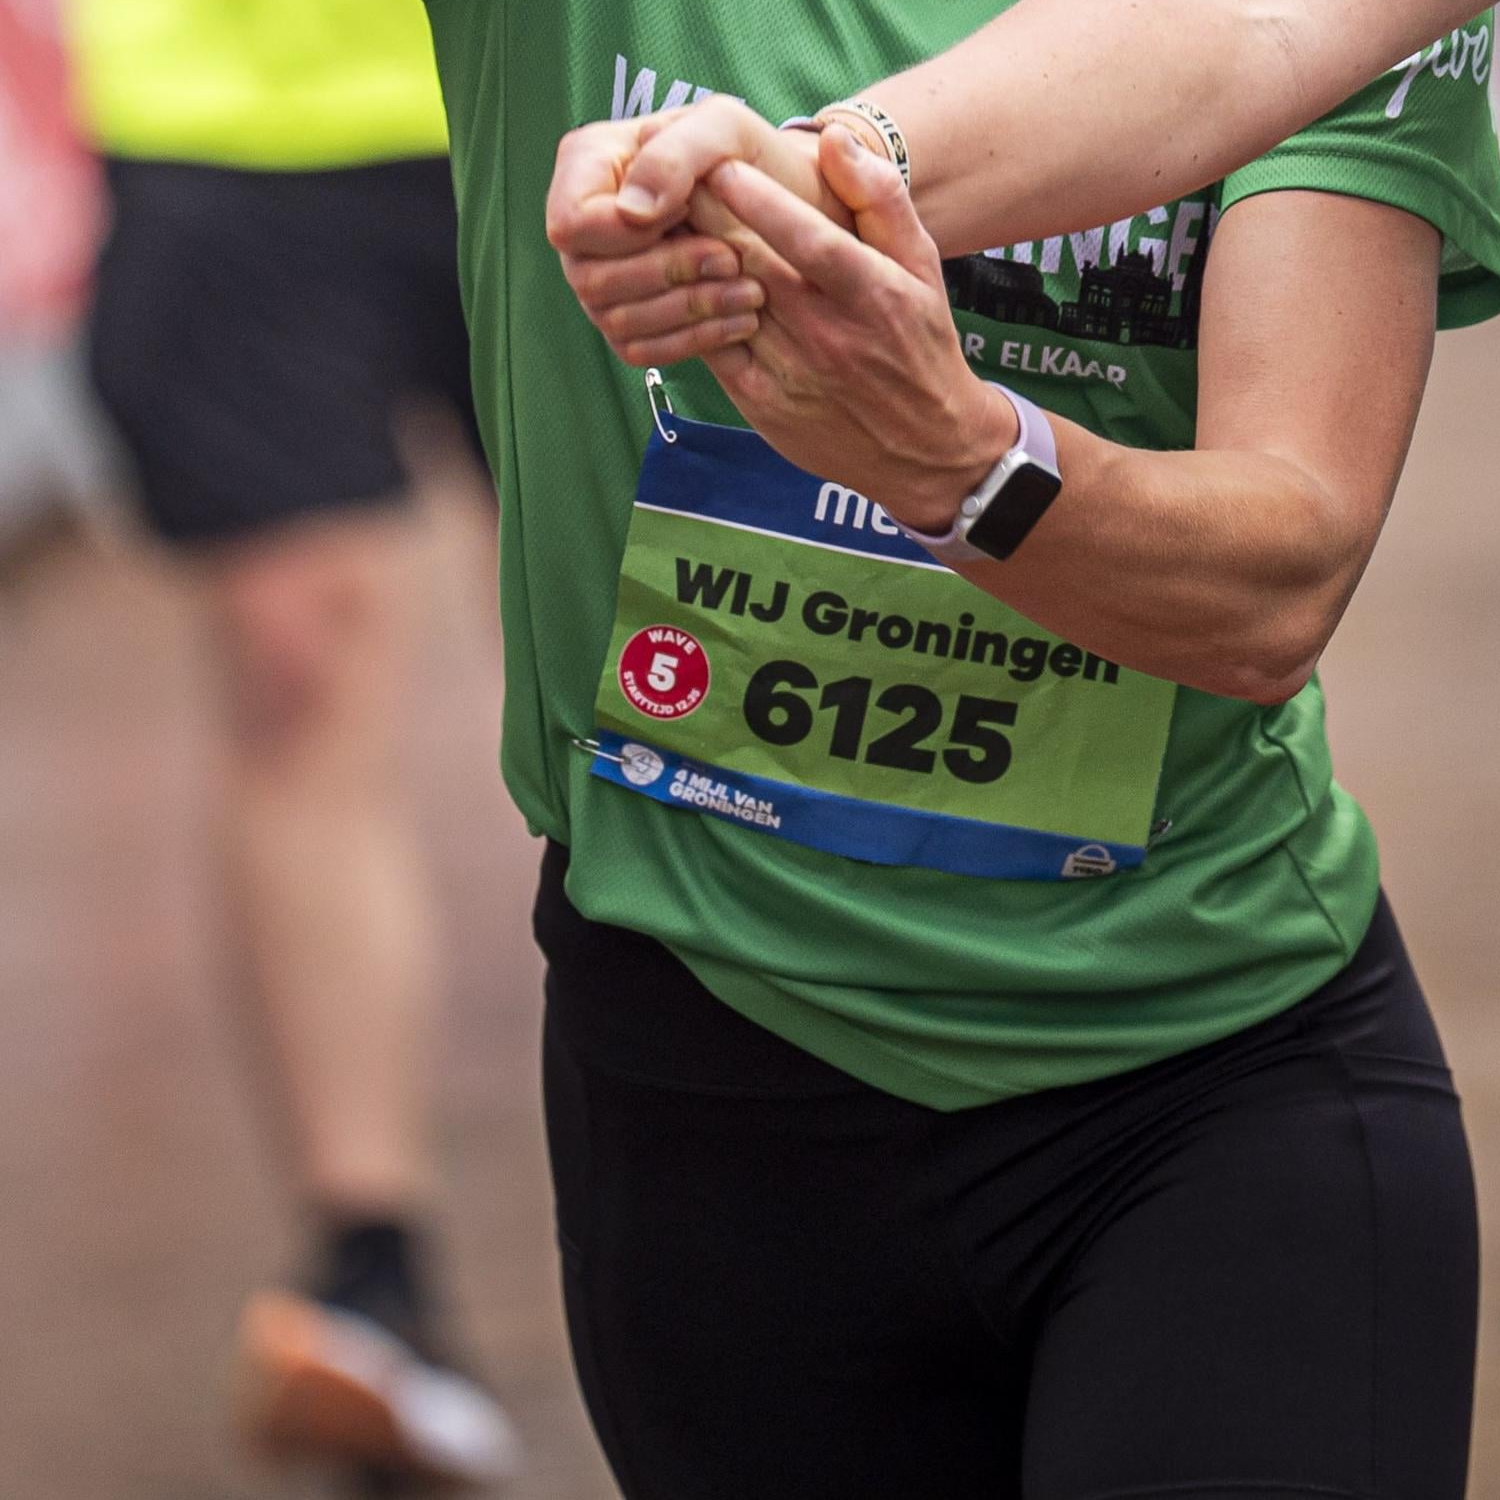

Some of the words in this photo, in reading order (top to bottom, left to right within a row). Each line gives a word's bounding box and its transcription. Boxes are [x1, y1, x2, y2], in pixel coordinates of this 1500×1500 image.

[1001, 341, 1127, 390] ELKAAR
[647, 629, 697, 655] WAVE
[675, 557, 791, 623] WIJ
[802, 591, 1120, 684] Groningen
[647, 652, 679, 692] 5
[743, 660, 1018, 784] 6125
[669, 782, 782, 829] GRONINGEN
[674, 769, 688, 783] 4
[689, 773, 729, 800] MIJL
[734, 790, 774, 814] VAN
